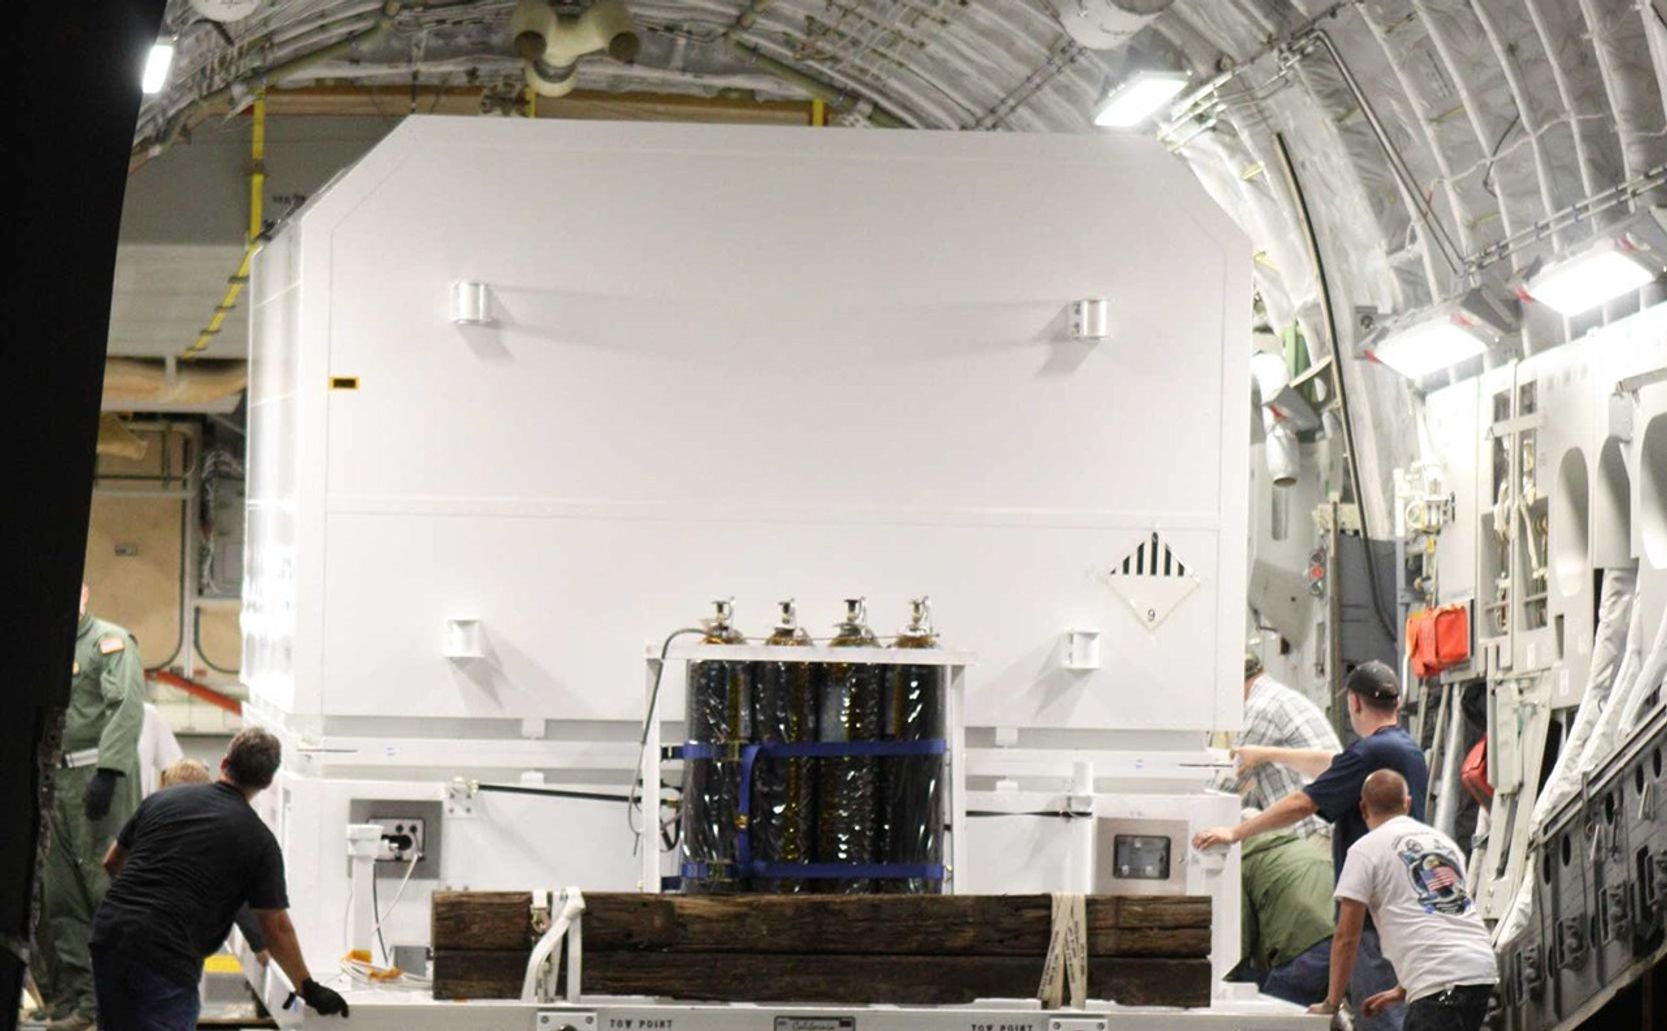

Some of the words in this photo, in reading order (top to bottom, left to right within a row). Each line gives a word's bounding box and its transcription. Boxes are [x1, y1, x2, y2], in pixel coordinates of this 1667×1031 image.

[1147, 608, 1156, 622] 9
[609, 1019, 632, 1029] TOW
[639, 1019, 672, 1029] POINT
